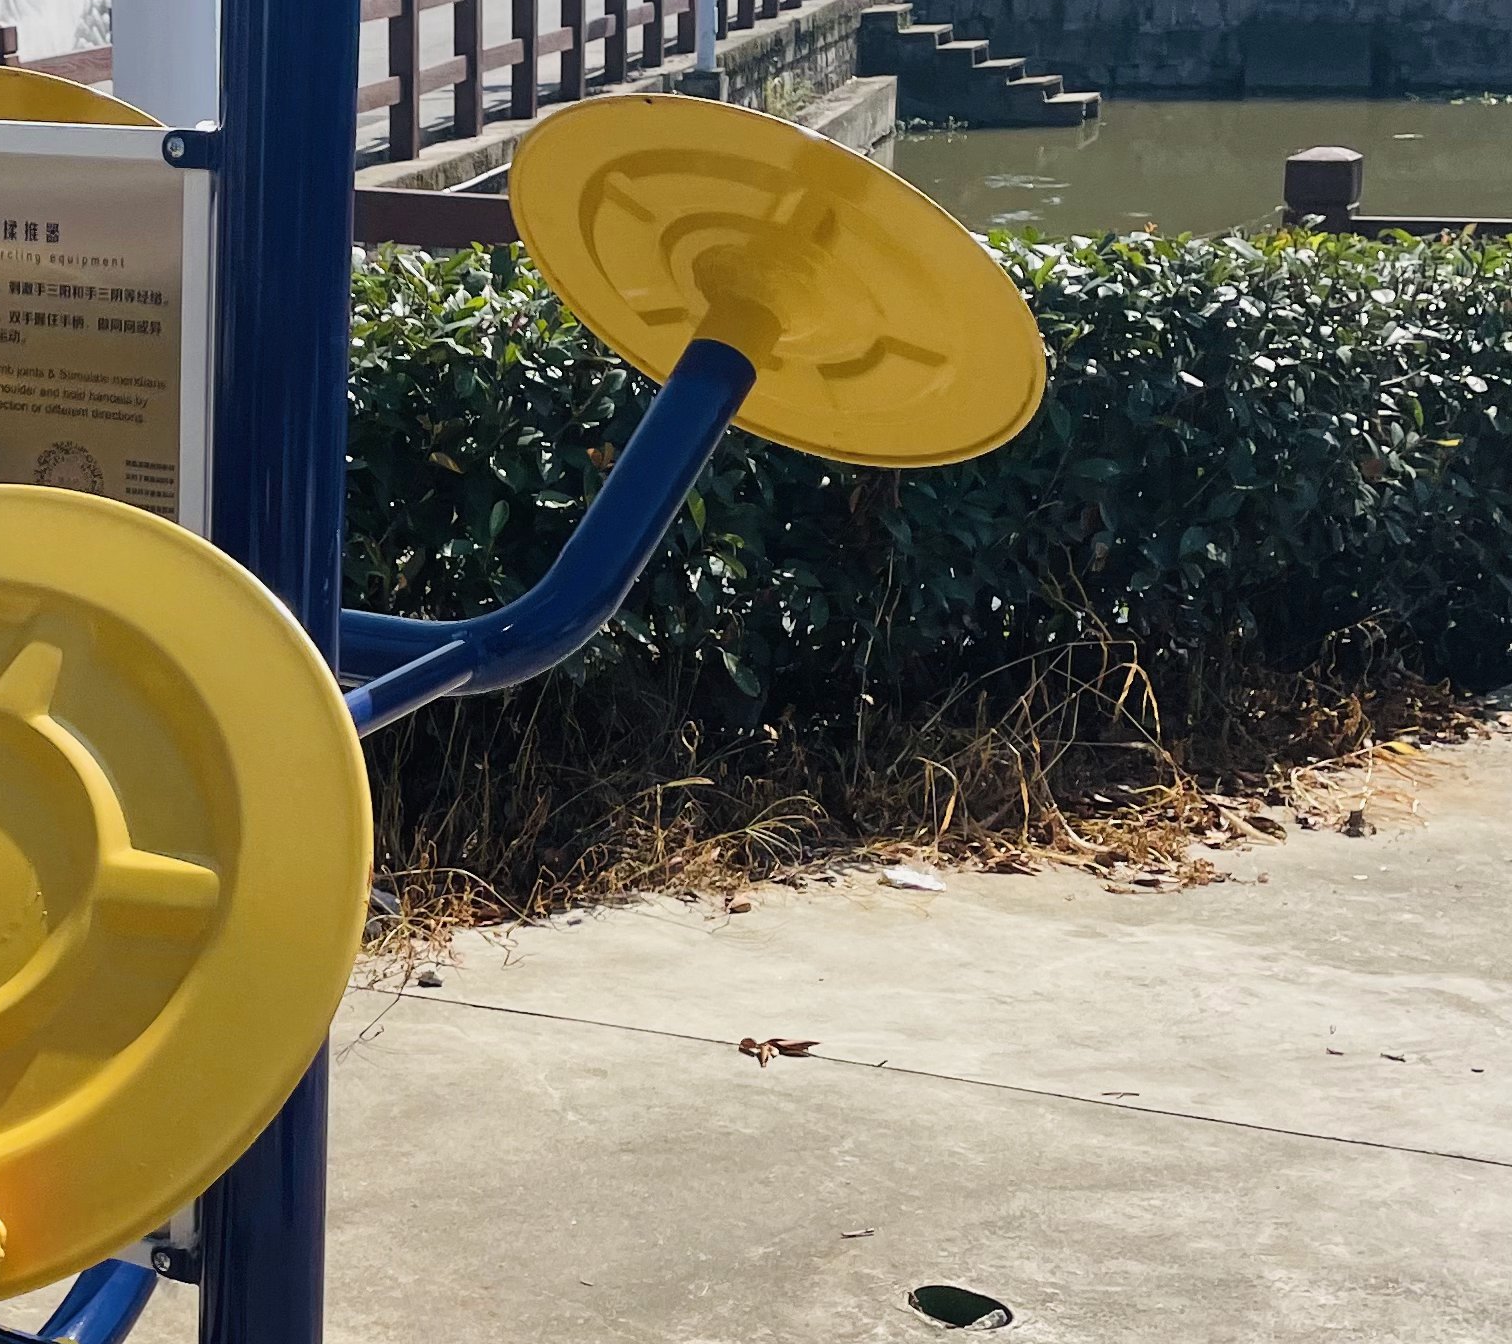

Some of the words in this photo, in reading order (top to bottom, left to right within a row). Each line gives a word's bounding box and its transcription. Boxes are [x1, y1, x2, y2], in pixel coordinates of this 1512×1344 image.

[49, 253, 126, 270] equipment
[39, 387, 60, 399] and
[31, 404, 42, 413] or
